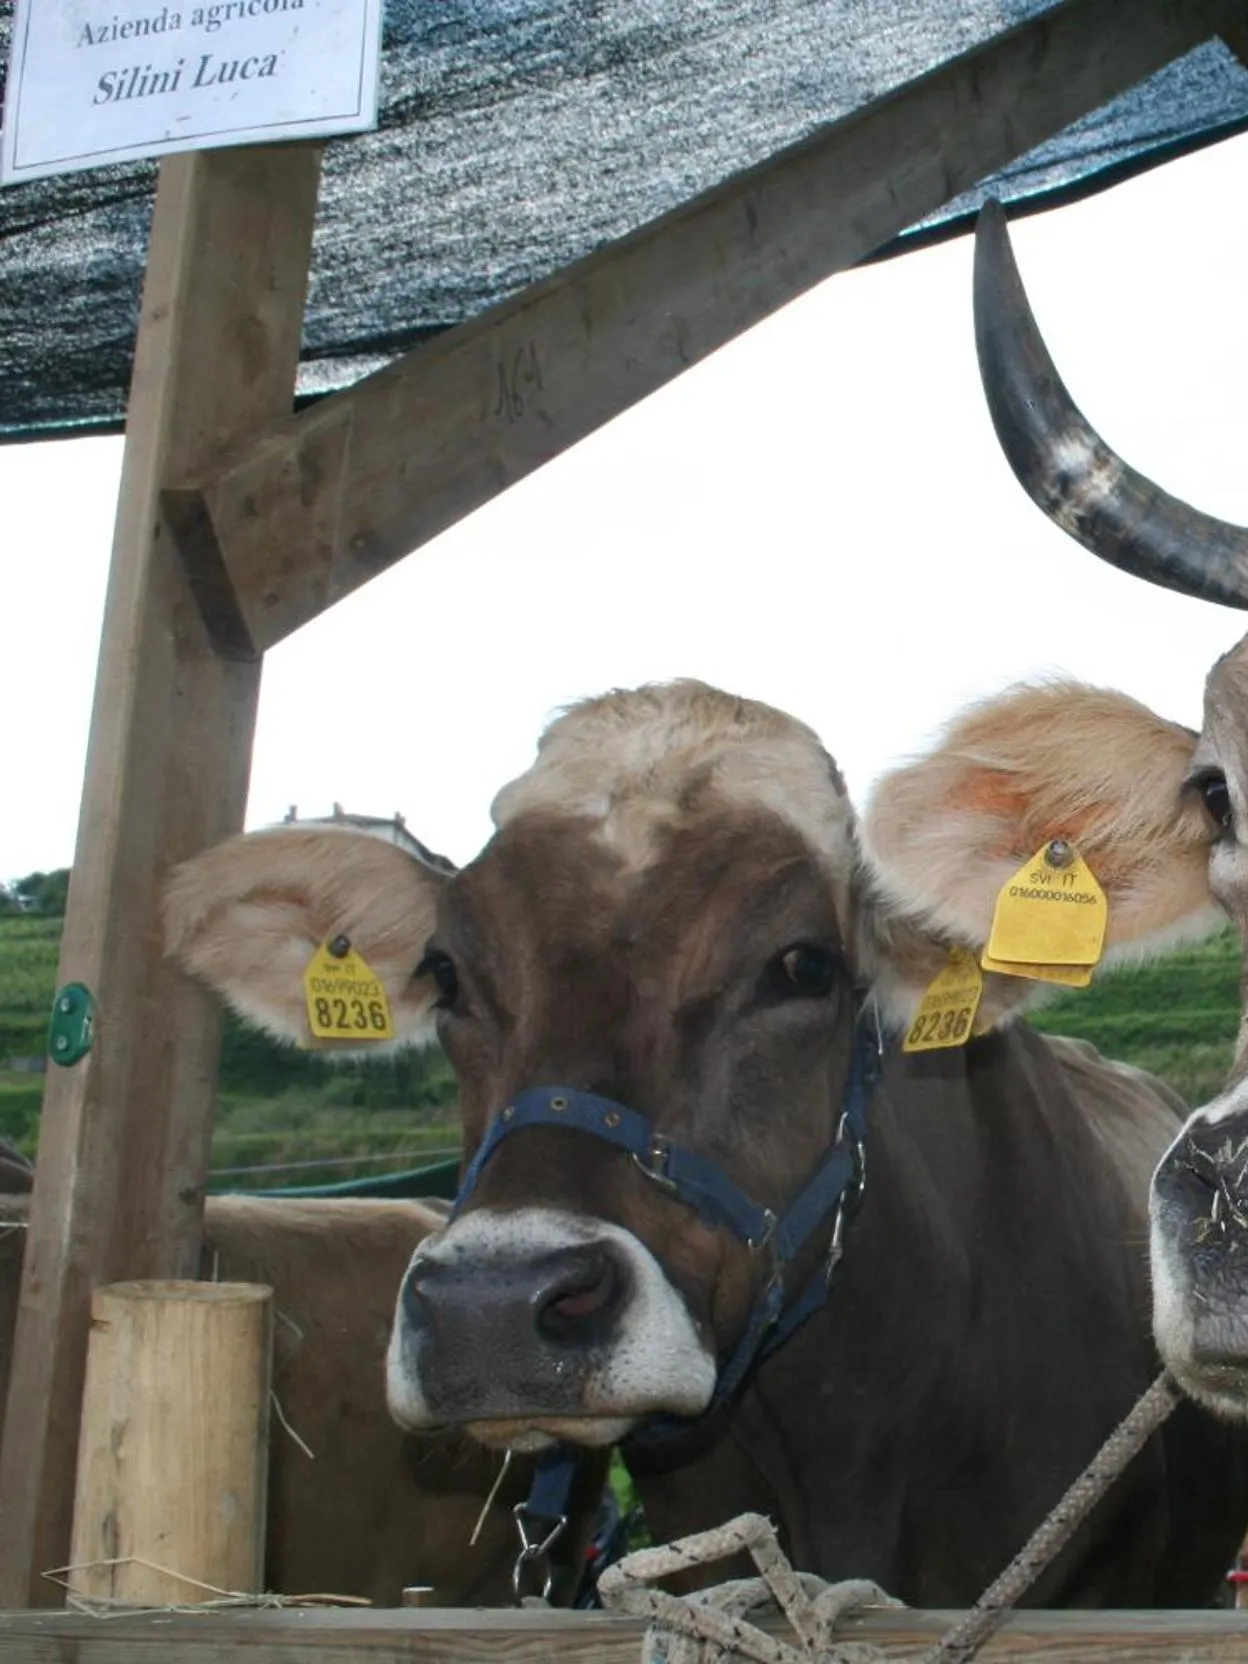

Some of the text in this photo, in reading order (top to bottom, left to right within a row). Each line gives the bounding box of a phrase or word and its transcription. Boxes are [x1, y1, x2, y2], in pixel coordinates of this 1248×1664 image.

[76, 7, 183, 48] Azienda
[92, 51, 279, 106] Silini Luca
[315, 997, 387, 1031] 8236
[908, 1007, 971, 1045] 8236
